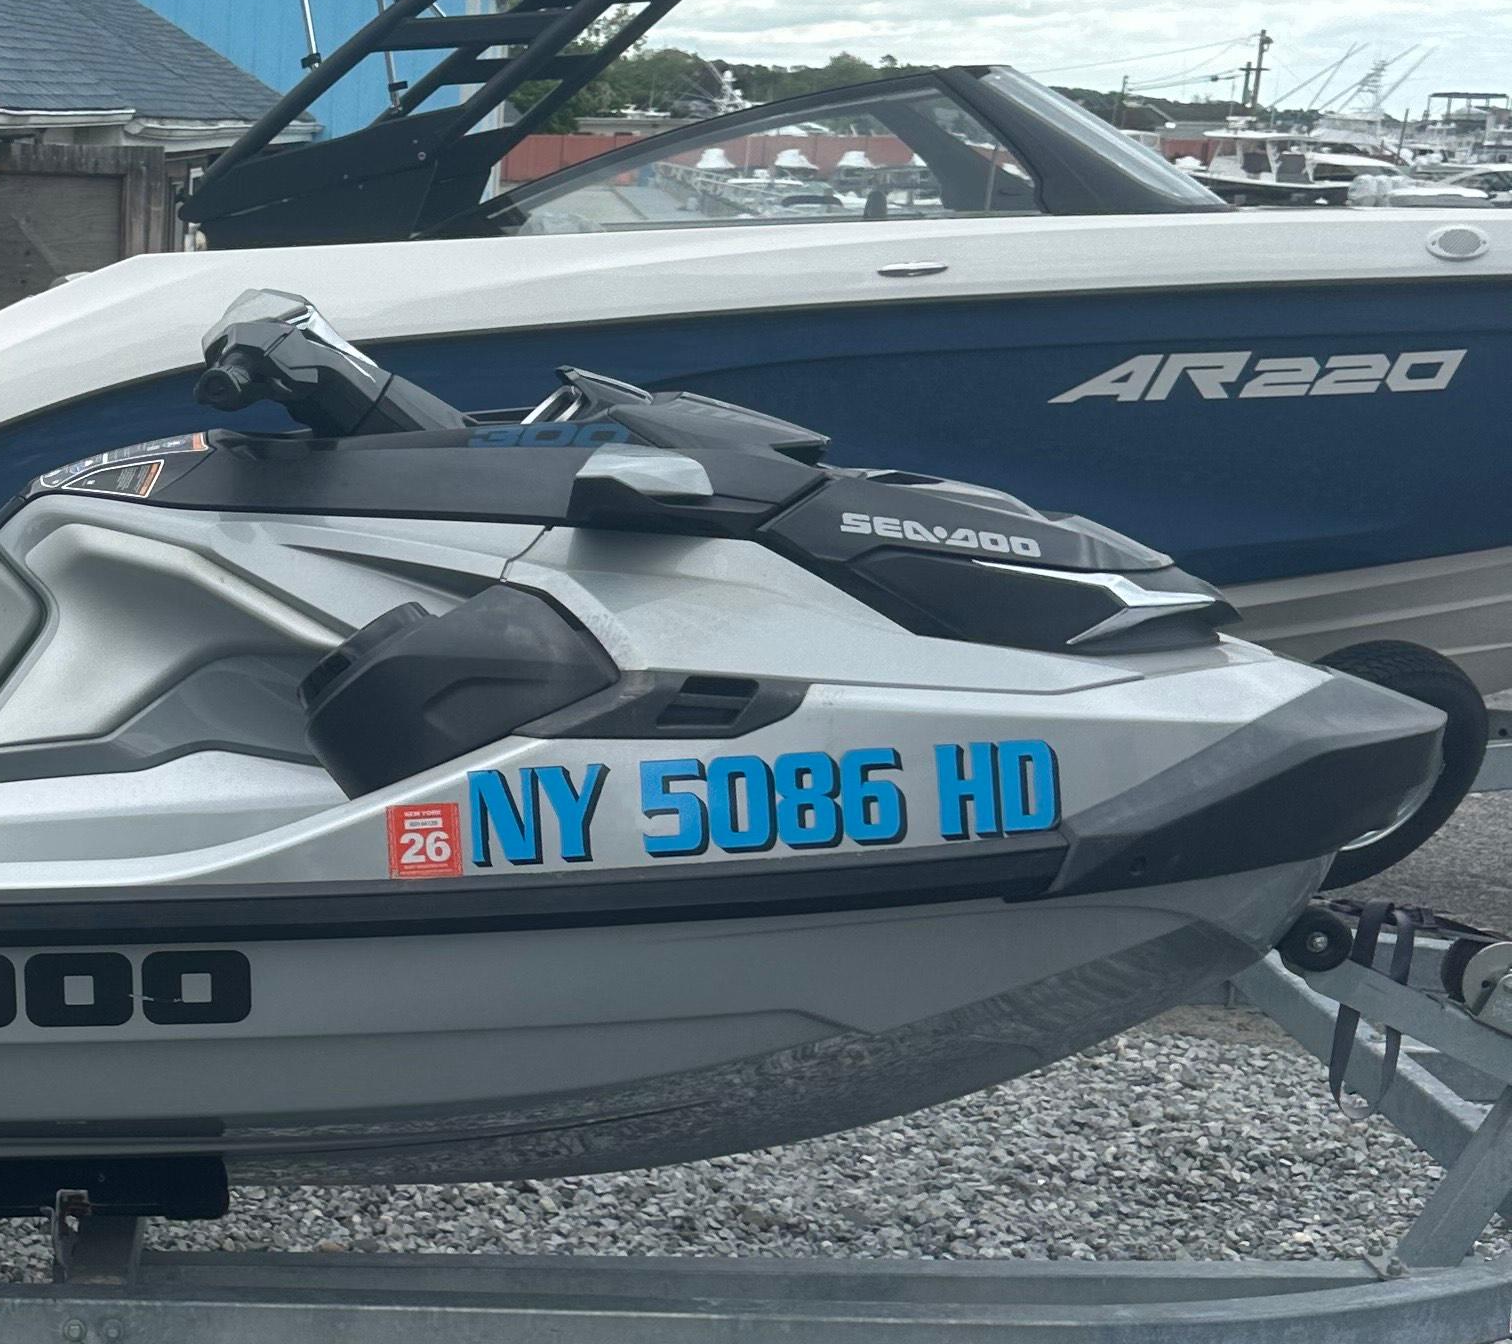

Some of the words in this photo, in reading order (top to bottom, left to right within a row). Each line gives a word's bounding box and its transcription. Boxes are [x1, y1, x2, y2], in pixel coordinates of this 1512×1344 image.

[1047, 349, 1467, 404] AR220
[467, 763, 611, 868] NY
[640, 747, 908, 857] 5086
[934, 739, 1061, 841] HD
[399, 831, 452, 864] 26
